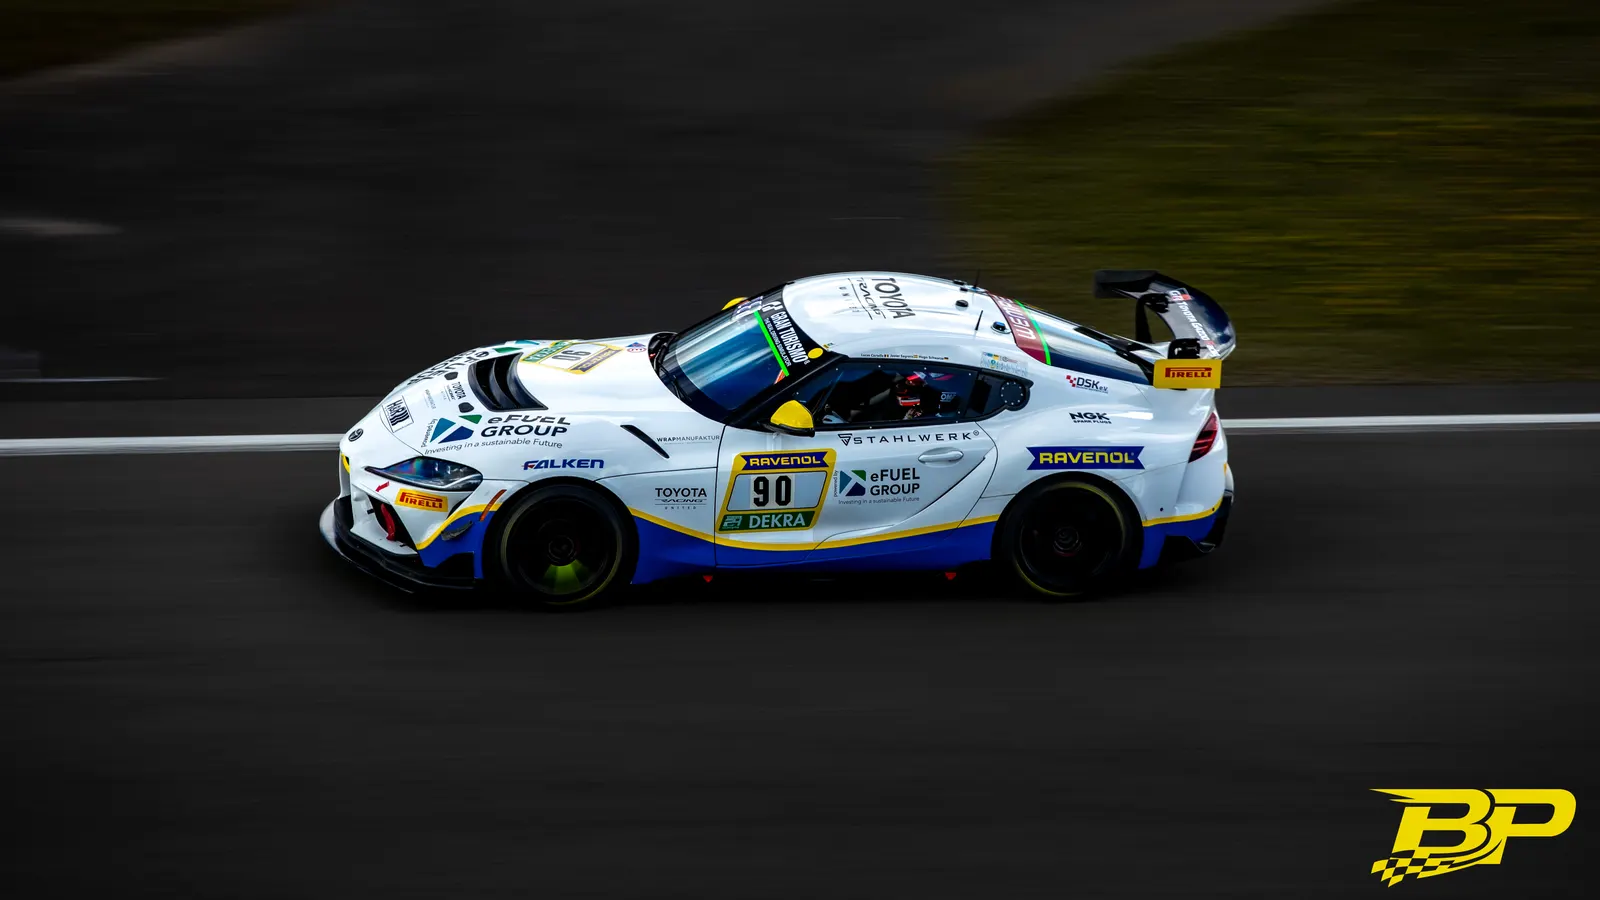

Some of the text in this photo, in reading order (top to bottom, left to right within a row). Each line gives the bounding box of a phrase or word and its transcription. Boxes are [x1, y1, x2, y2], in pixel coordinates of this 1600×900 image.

[871, 277, 916, 319] TOYOTA
[1177, 301, 1198, 323] TOYOTA
[770, 311, 793, 331] GRAN
[551, 349, 592, 361] 90
[1165, 367, 1213, 378] PIRELLI
[1076, 376, 1100, 390] DSK
[487, 414, 572, 426] eFUEL
[1069, 411, 1110, 421] NGK
[480, 424, 568, 438] GROUP
[424, 442, 463, 455] Investing
[481, 437, 531, 447] sustainable
[533, 438, 563, 449] Future
[656, 435, 721, 443] WRAPMANUFAKTUR
[523, 458, 605, 471] FALKEN
[749, 454, 821, 467] RAVENOL
[870, 467, 920, 482] eFUEL
[654, 487, 708, 498] TOYOTA
[753, 475, 792, 507] 90
[870, 483, 920, 496] GROUP
[400, 491, 443, 509] PIRELLI
[748, 512, 806, 529] DEKRA
